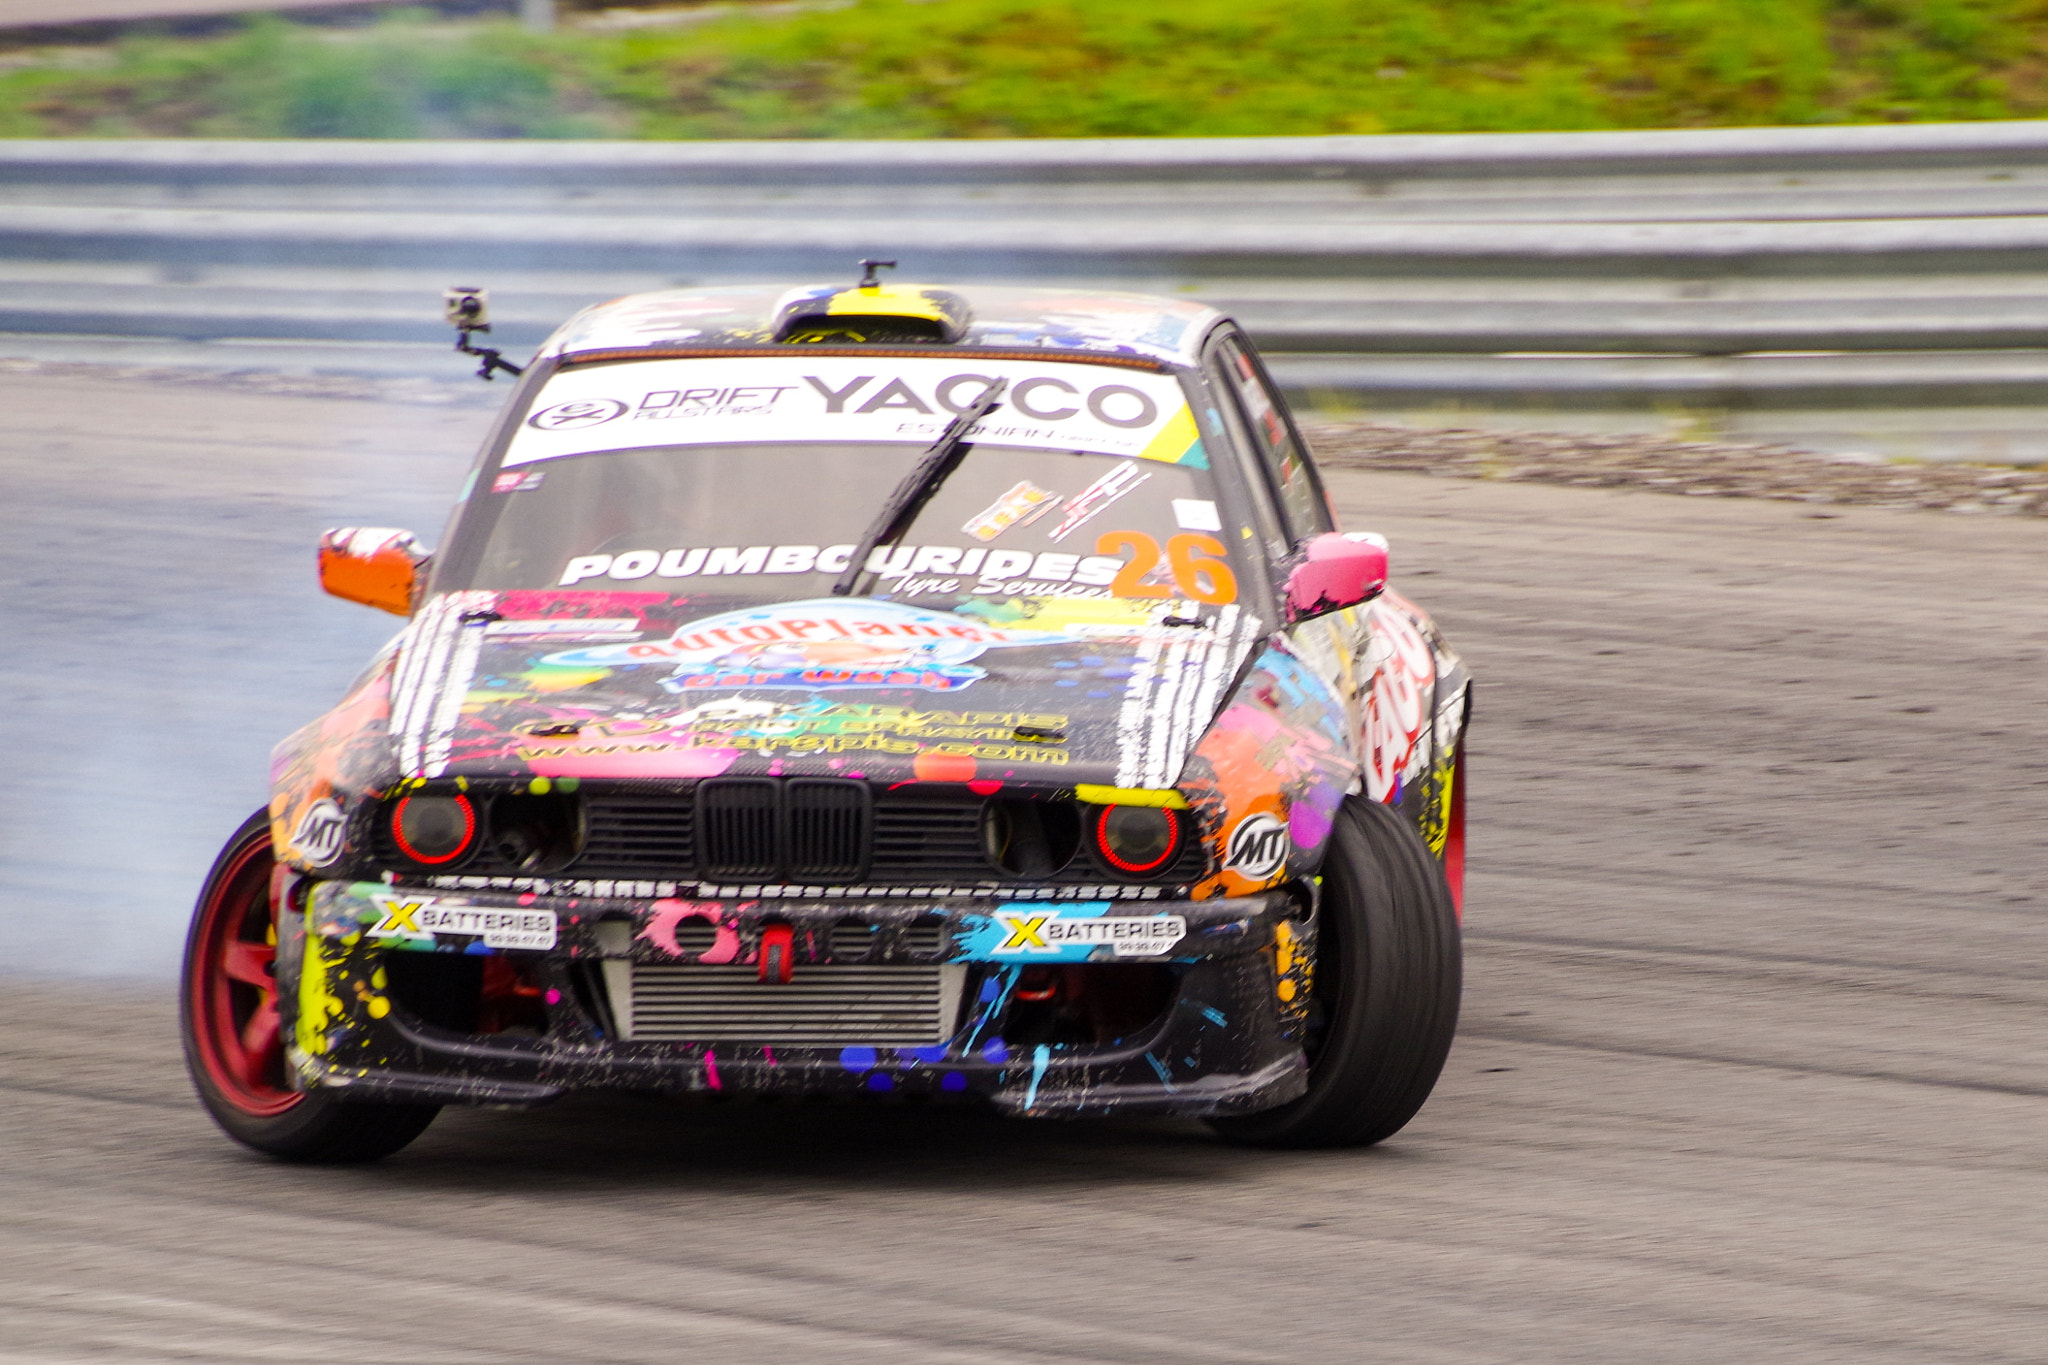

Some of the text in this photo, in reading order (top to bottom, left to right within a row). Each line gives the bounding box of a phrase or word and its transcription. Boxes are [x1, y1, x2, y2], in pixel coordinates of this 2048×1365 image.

[637, 386, 799, 410] DRIFT
[801, 374, 1158, 429] YACCO
[557, 543, 1126, 588] POUMBOURIDES
[1094, 530, 1238, 606] 26
[890, 571, 961, 597] Tyre
[1227, 828, 1285, 867] MT
[422, 909, 551, 932] BATTERIES
[1048, 920, 1181, 939] BATTERIES
